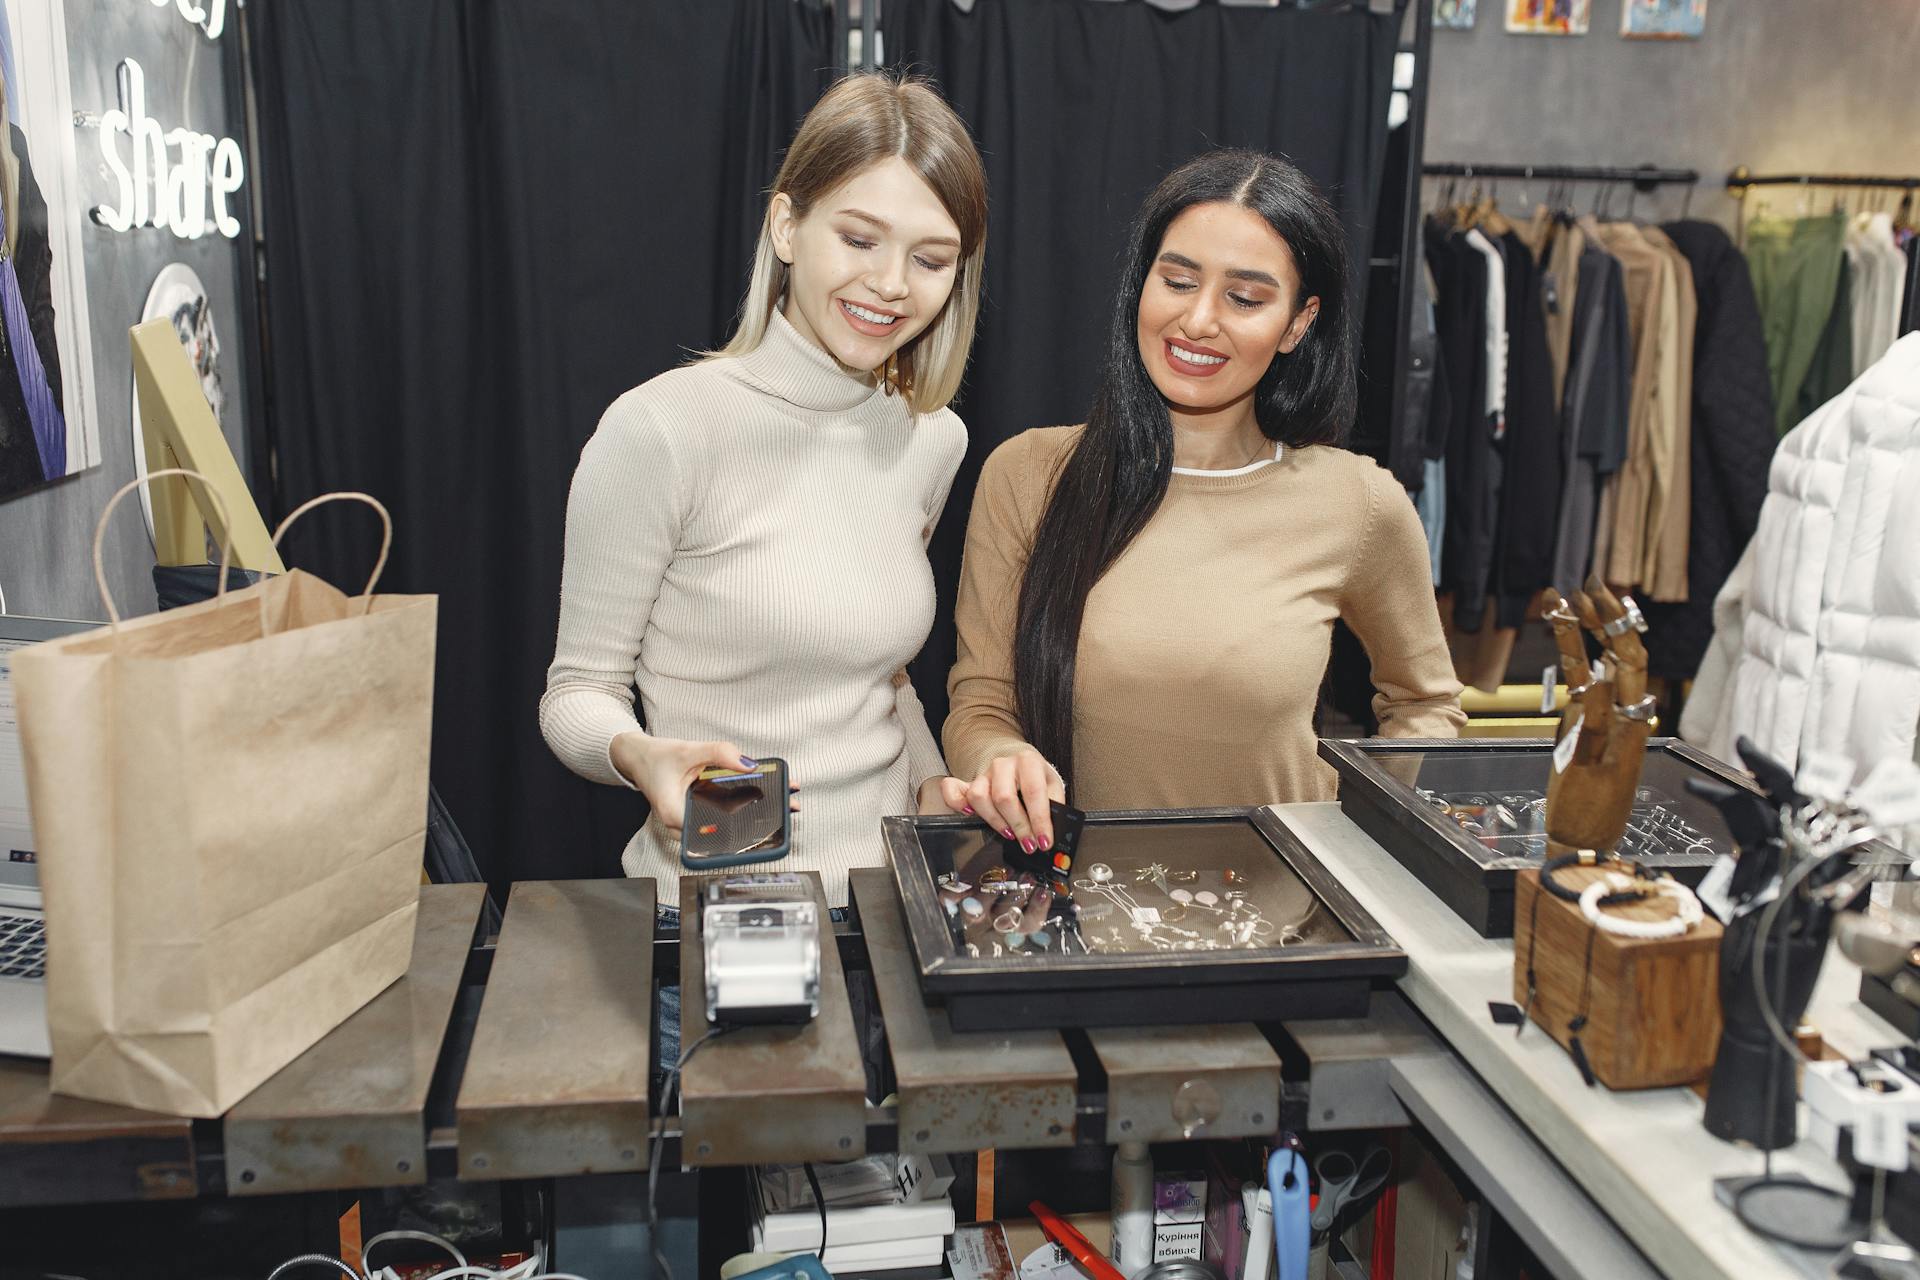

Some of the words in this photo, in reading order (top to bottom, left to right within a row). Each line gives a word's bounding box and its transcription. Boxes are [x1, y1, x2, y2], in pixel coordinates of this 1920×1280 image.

[99, 57, 243, 239] share
[1157, 1232, 1200, 1243] Куріння
[1158, 1247, 1197, 1257] вбиває
